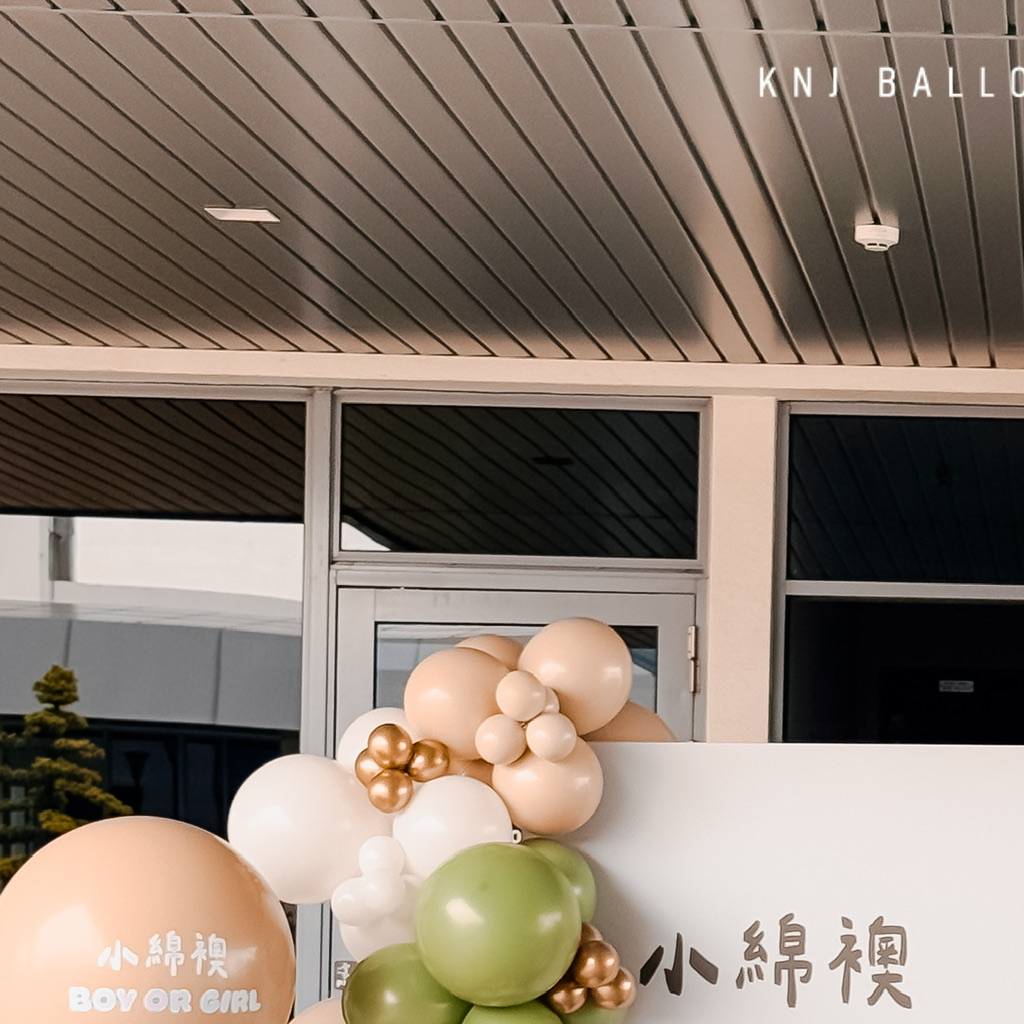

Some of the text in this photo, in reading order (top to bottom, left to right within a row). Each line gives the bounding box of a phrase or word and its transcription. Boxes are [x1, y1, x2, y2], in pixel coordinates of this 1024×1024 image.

[98, 930, 228, 979] 小綿襖
[639, 913, 912, 1009] 小綿襖
[68, 986, 261, 1014] BOY OR GIRL
